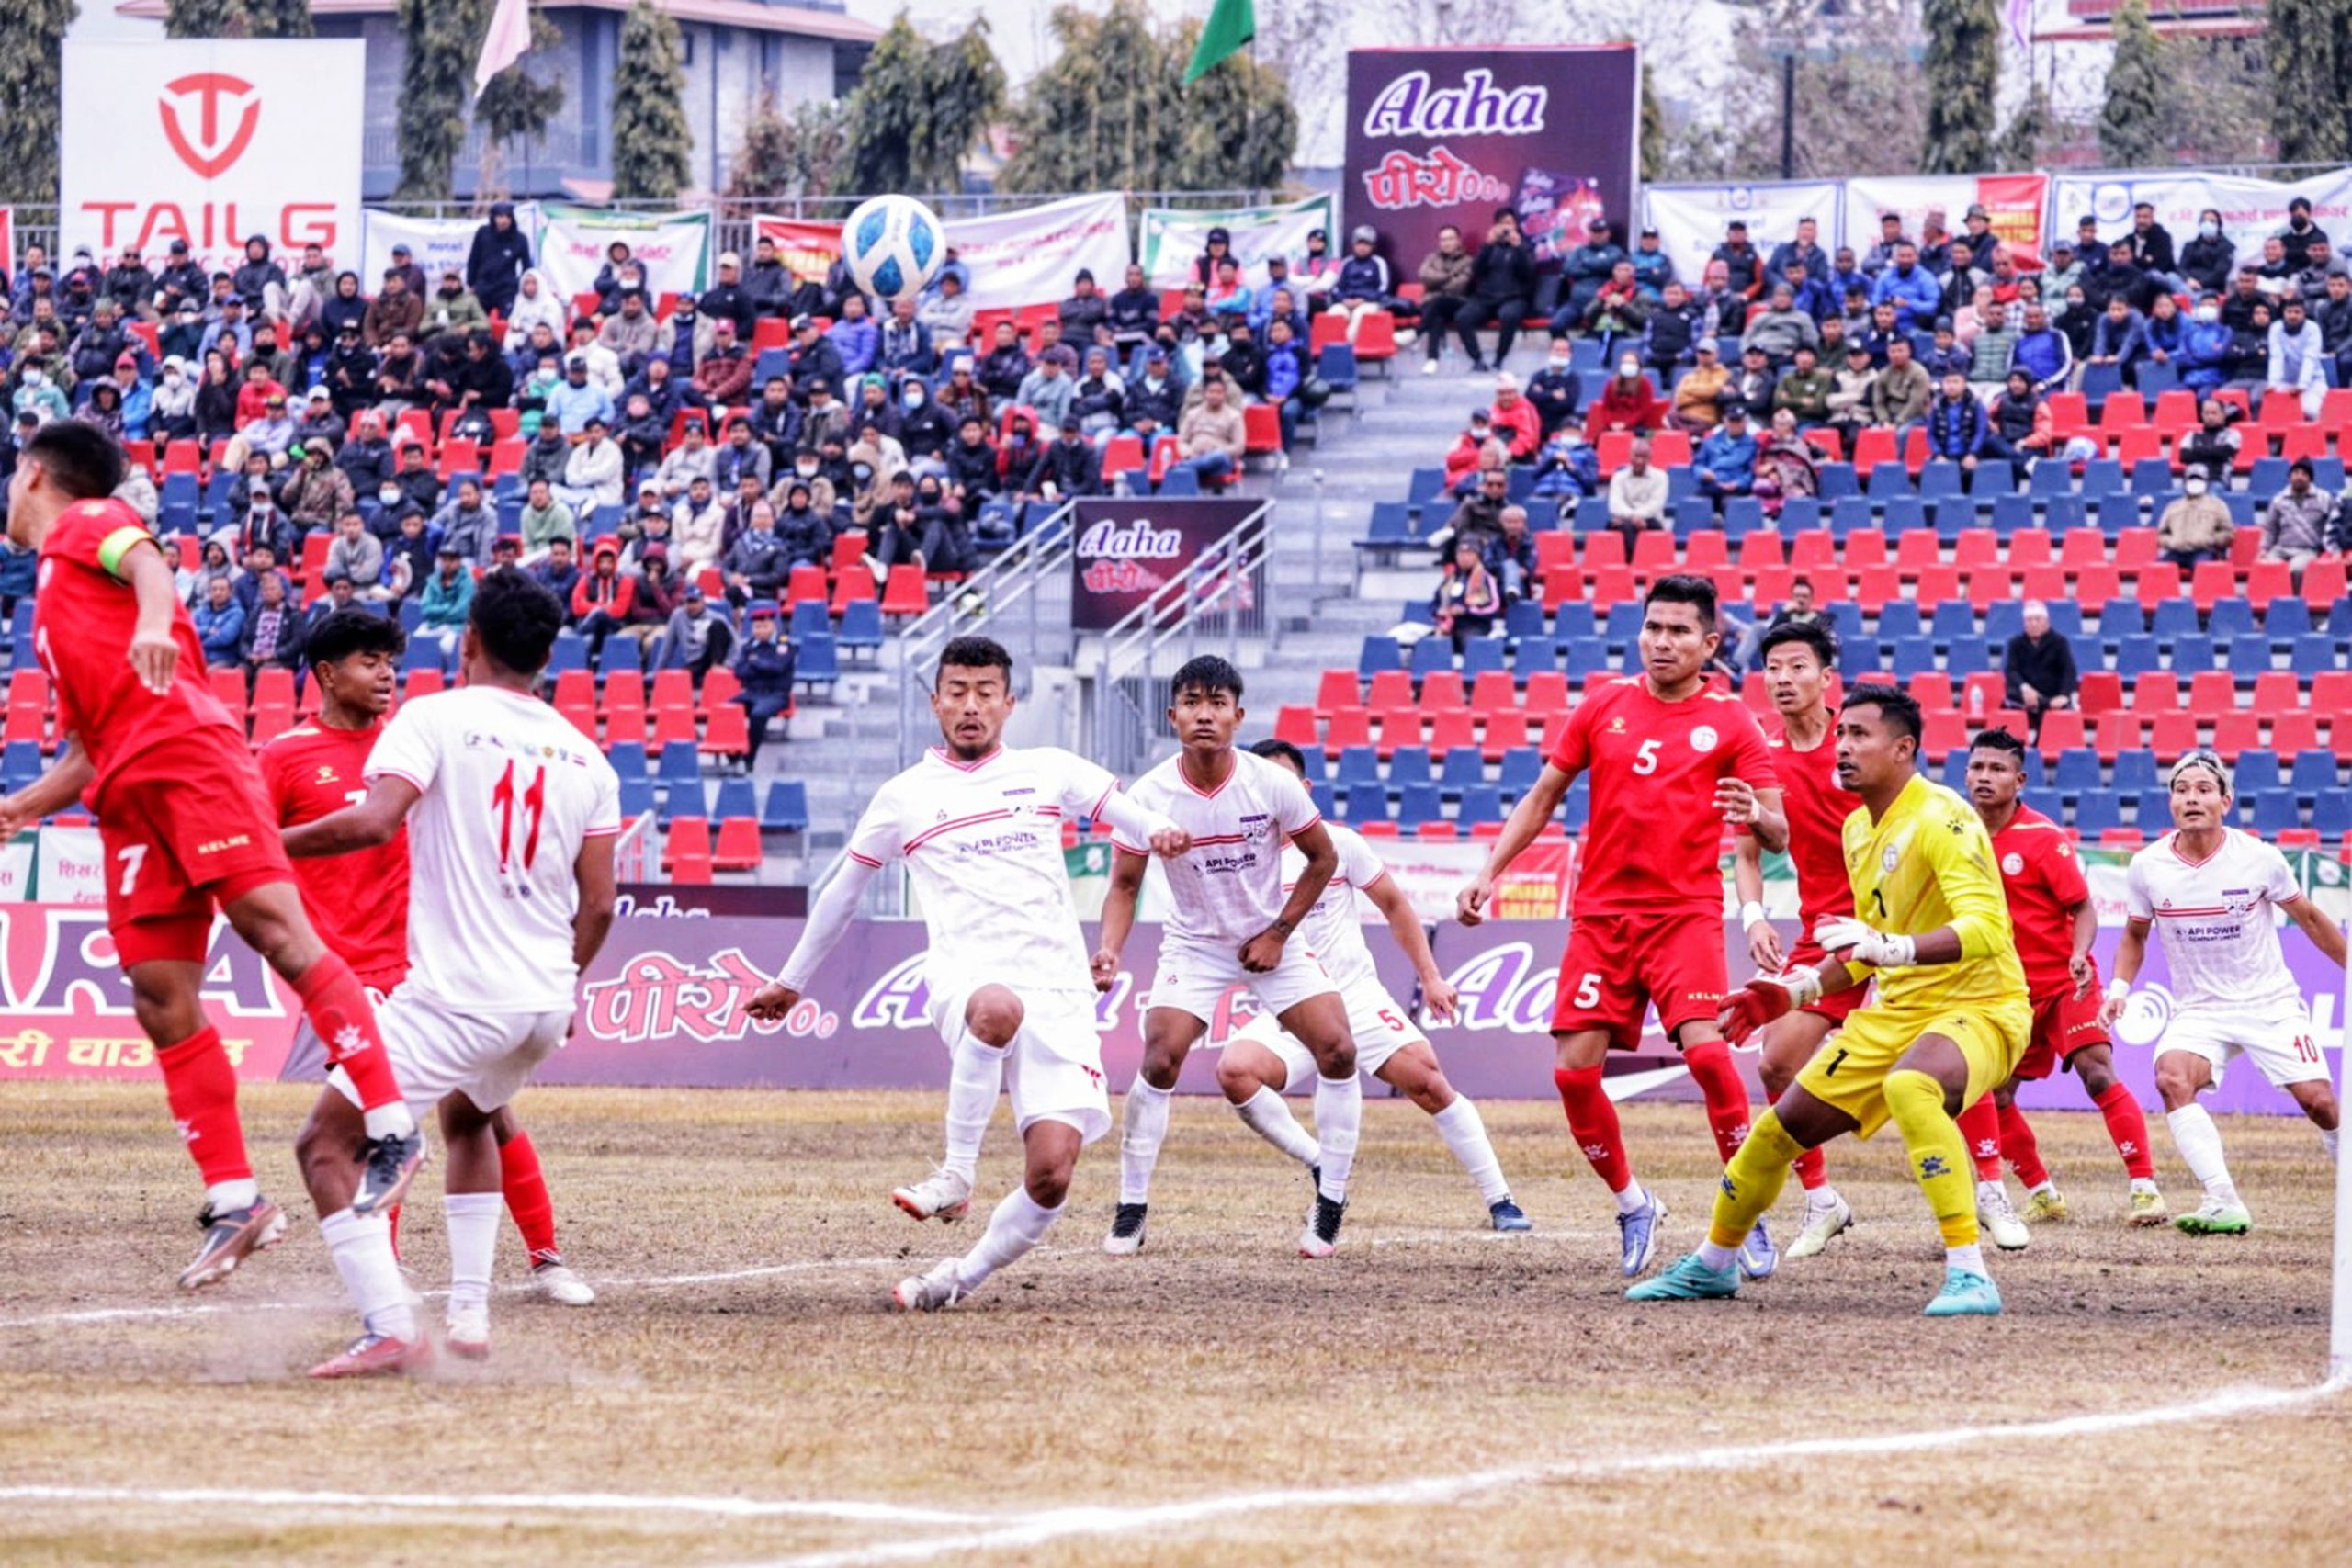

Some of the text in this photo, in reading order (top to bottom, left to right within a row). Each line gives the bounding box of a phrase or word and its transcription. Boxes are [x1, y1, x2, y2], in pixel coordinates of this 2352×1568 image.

[1363, 69, 1547, 137] Aaha
[81, 201, 337, 249] TAILG
[1077, 519, 1182, 558] Aaha
[1632, 739, 1662, 775] 5
[492, 758, 545, 874] 11
[117, 843, 148, 896] 7
[1205, 859, 1222, 867] API
[2188, 924, 2240, 935] API POWER
[1573, 973, 1602, 1009] 5
[1378, 1009, 1405, 1032] 5
[1826, 1048, 1849, 1077] 1
[2293, 1035, 2319, 1063] 10
